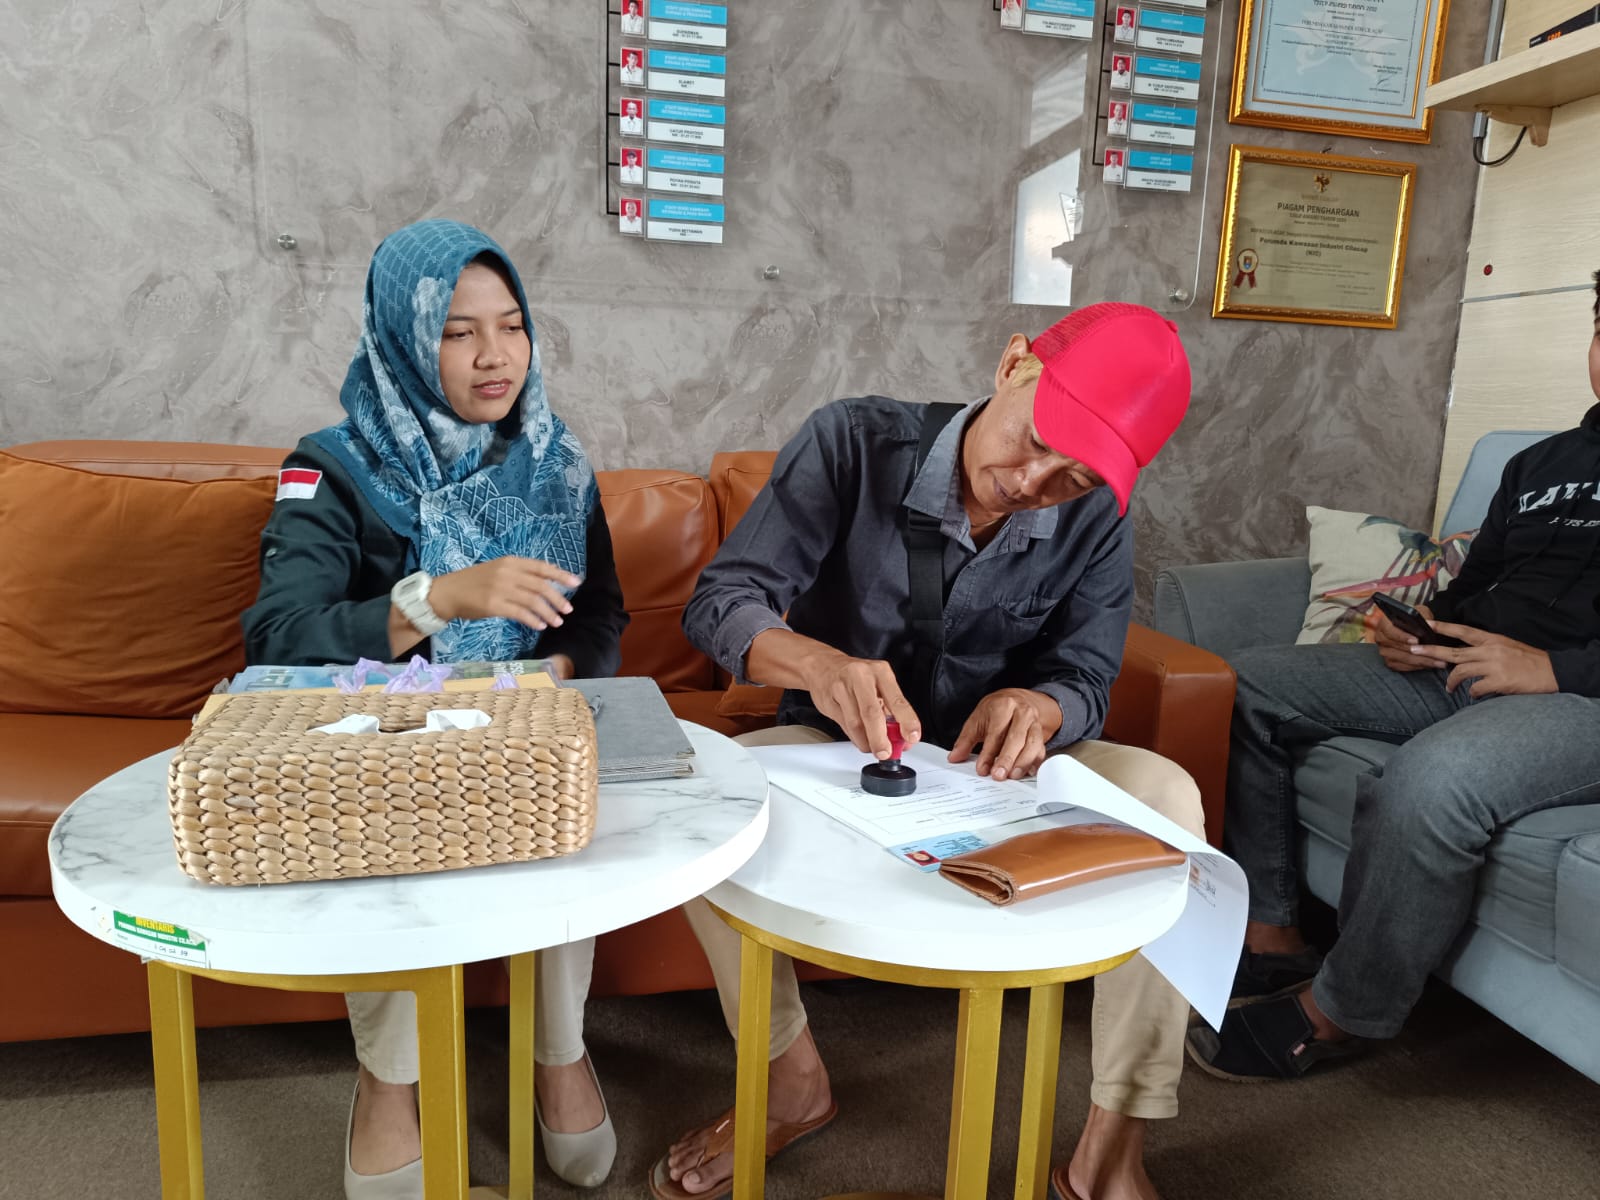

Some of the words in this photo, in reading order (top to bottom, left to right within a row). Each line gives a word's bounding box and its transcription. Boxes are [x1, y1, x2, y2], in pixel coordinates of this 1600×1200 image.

[1277, 202, 1305, 212] PIAGAM
[1307, 205, 1360, 217] PENGHARGAAN
[1260, 237, 1288, 246] Perumda
[1289, 240, 1319, 248] Kawasan
[1319, 242, 1344, 250] Industri
[1345, 244, 1368, 253] Cilacap
[135, 916, 175, 934] INVENTARIS
